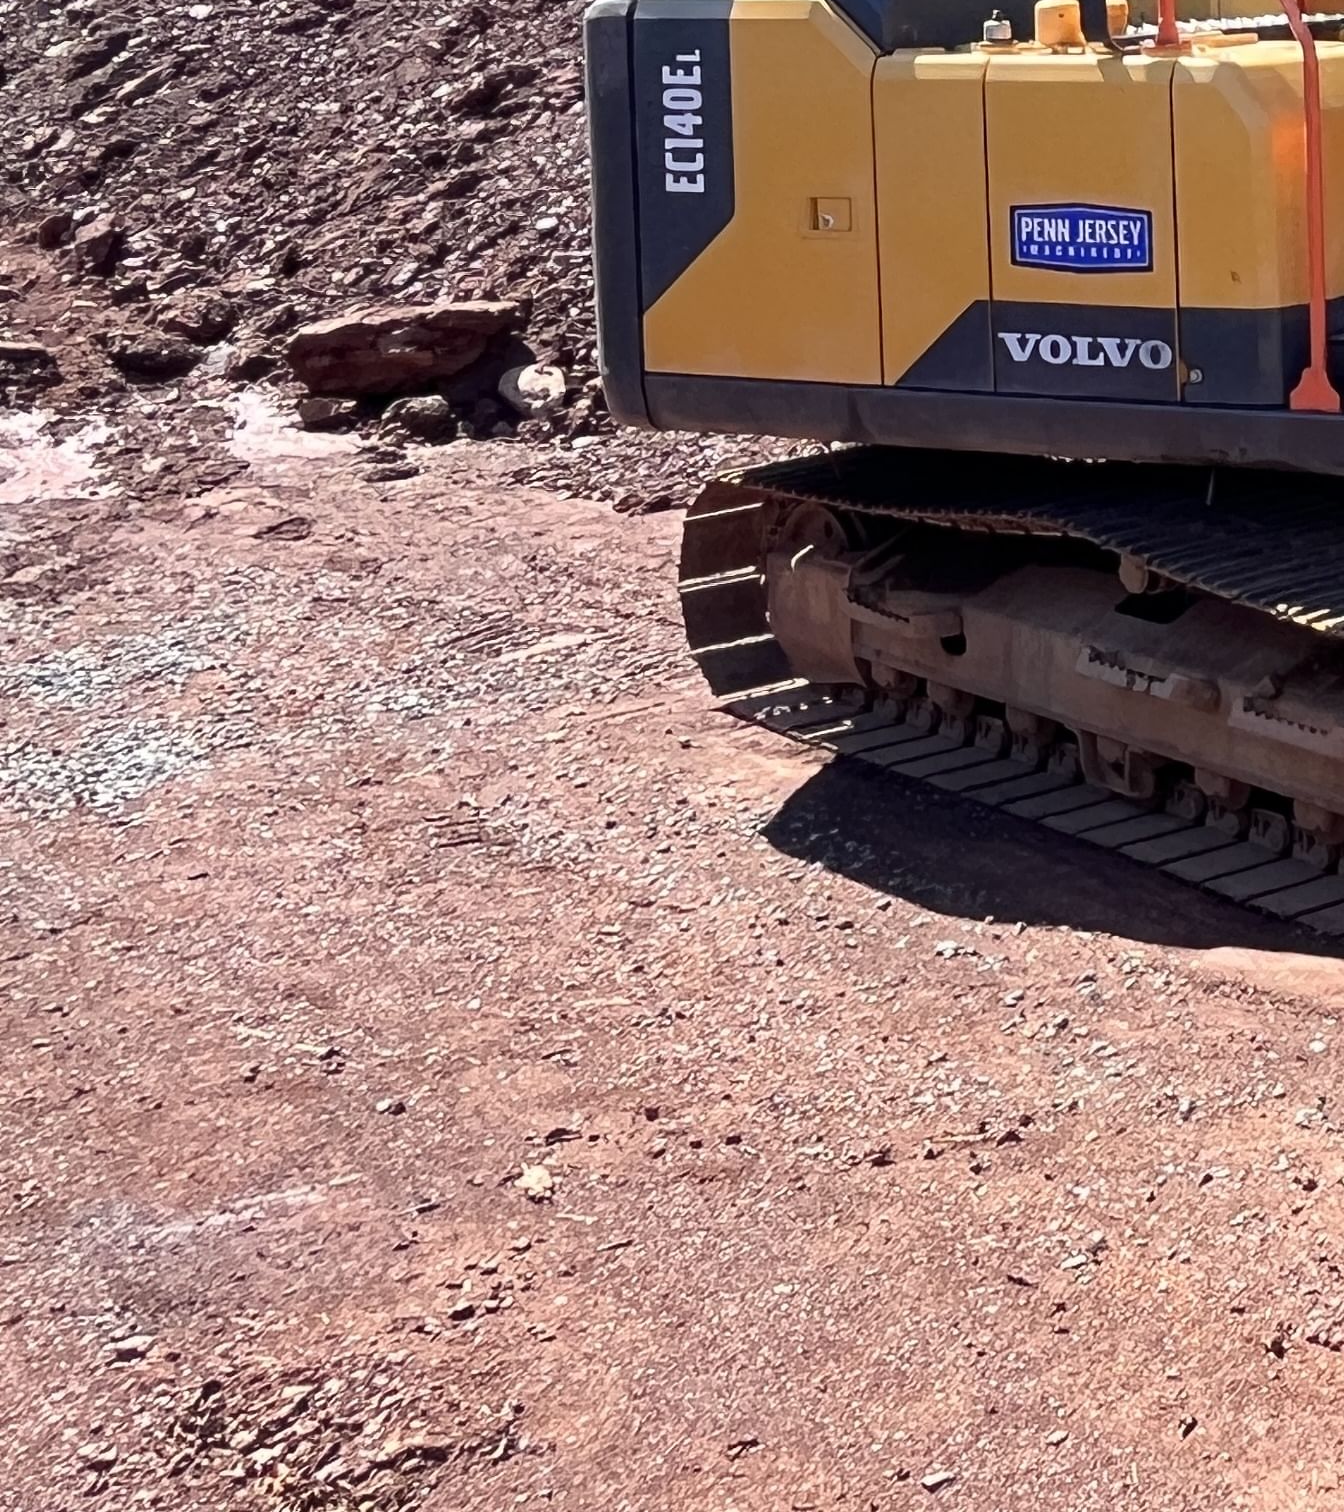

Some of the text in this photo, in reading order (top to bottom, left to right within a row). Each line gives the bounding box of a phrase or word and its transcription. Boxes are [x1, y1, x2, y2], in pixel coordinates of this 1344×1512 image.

[1021, 216, 1142, 246] PENN JERSEY
[997, 332, 1173, 370] VOLVO
